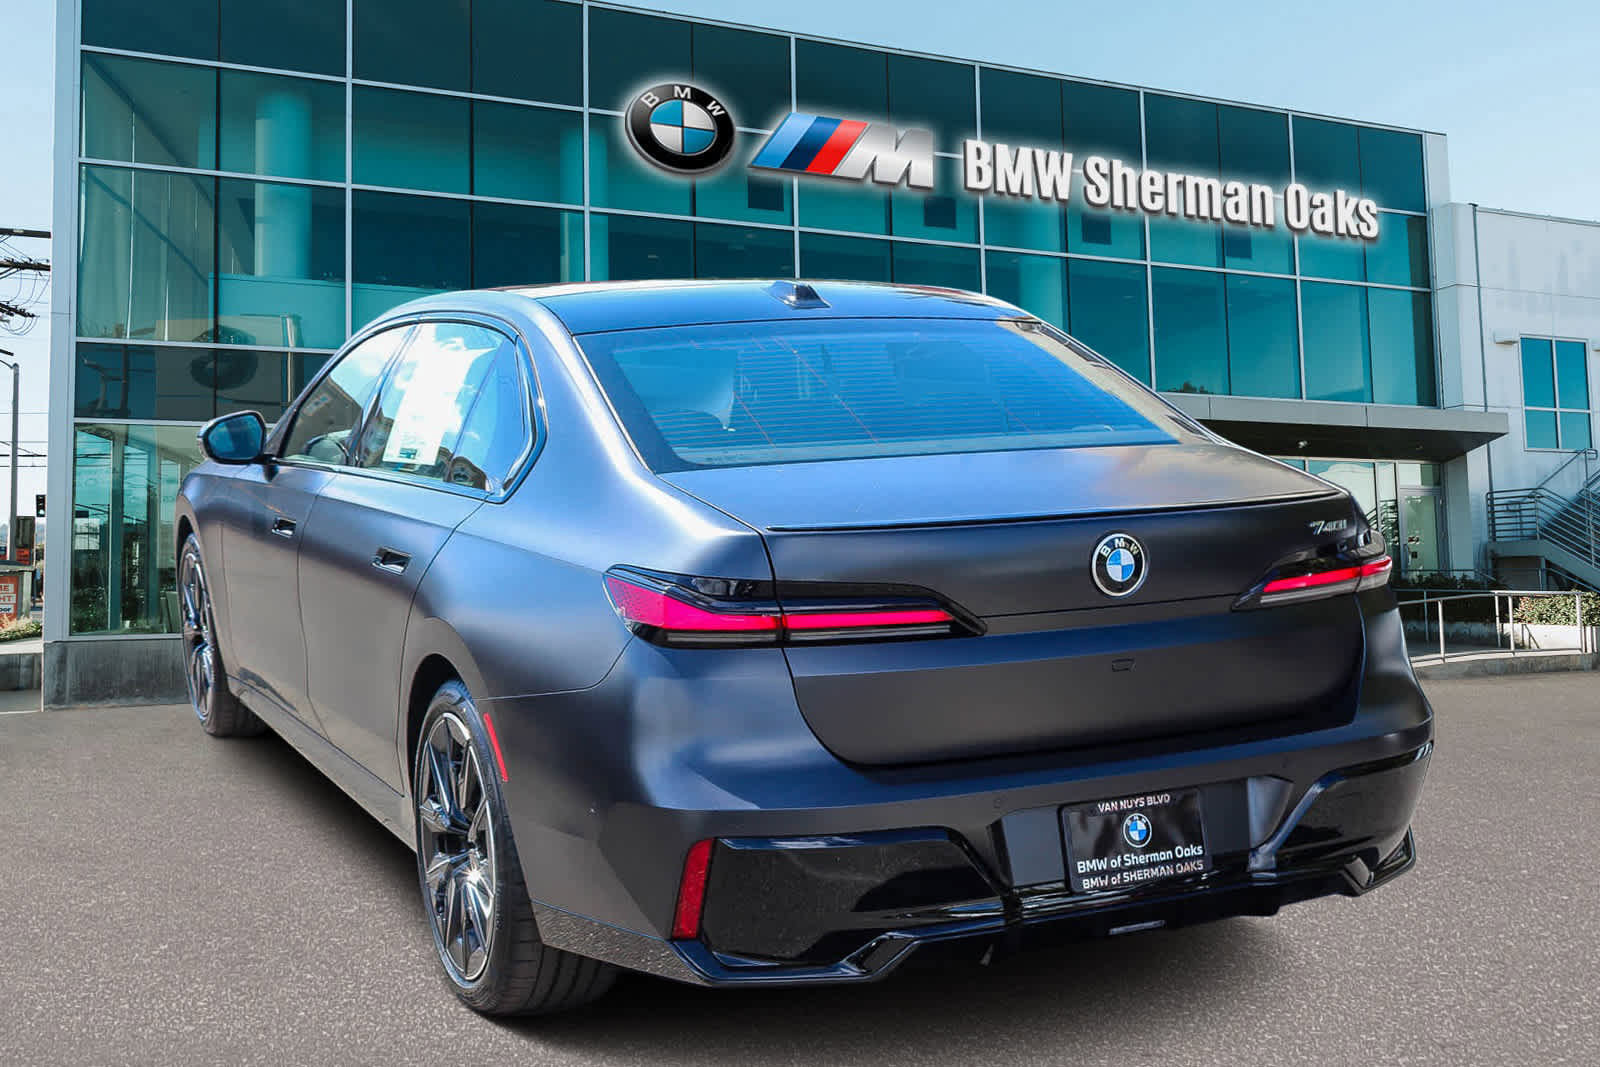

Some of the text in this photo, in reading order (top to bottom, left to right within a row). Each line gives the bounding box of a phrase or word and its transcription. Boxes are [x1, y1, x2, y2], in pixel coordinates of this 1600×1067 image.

[641, 85, 725, 117] BMW
[963, 138, 1379, 241] BMW Sherman Oaks
[1100, 537, 1139, 557] BMW
[1098, 793, 1170, 813] VAN NUYS BLVD
[1077, 844, 1203, 873] BMW of Sherman Oaks
[1082, 860, 1204, 889] BMW of SHERMAN OAKS
